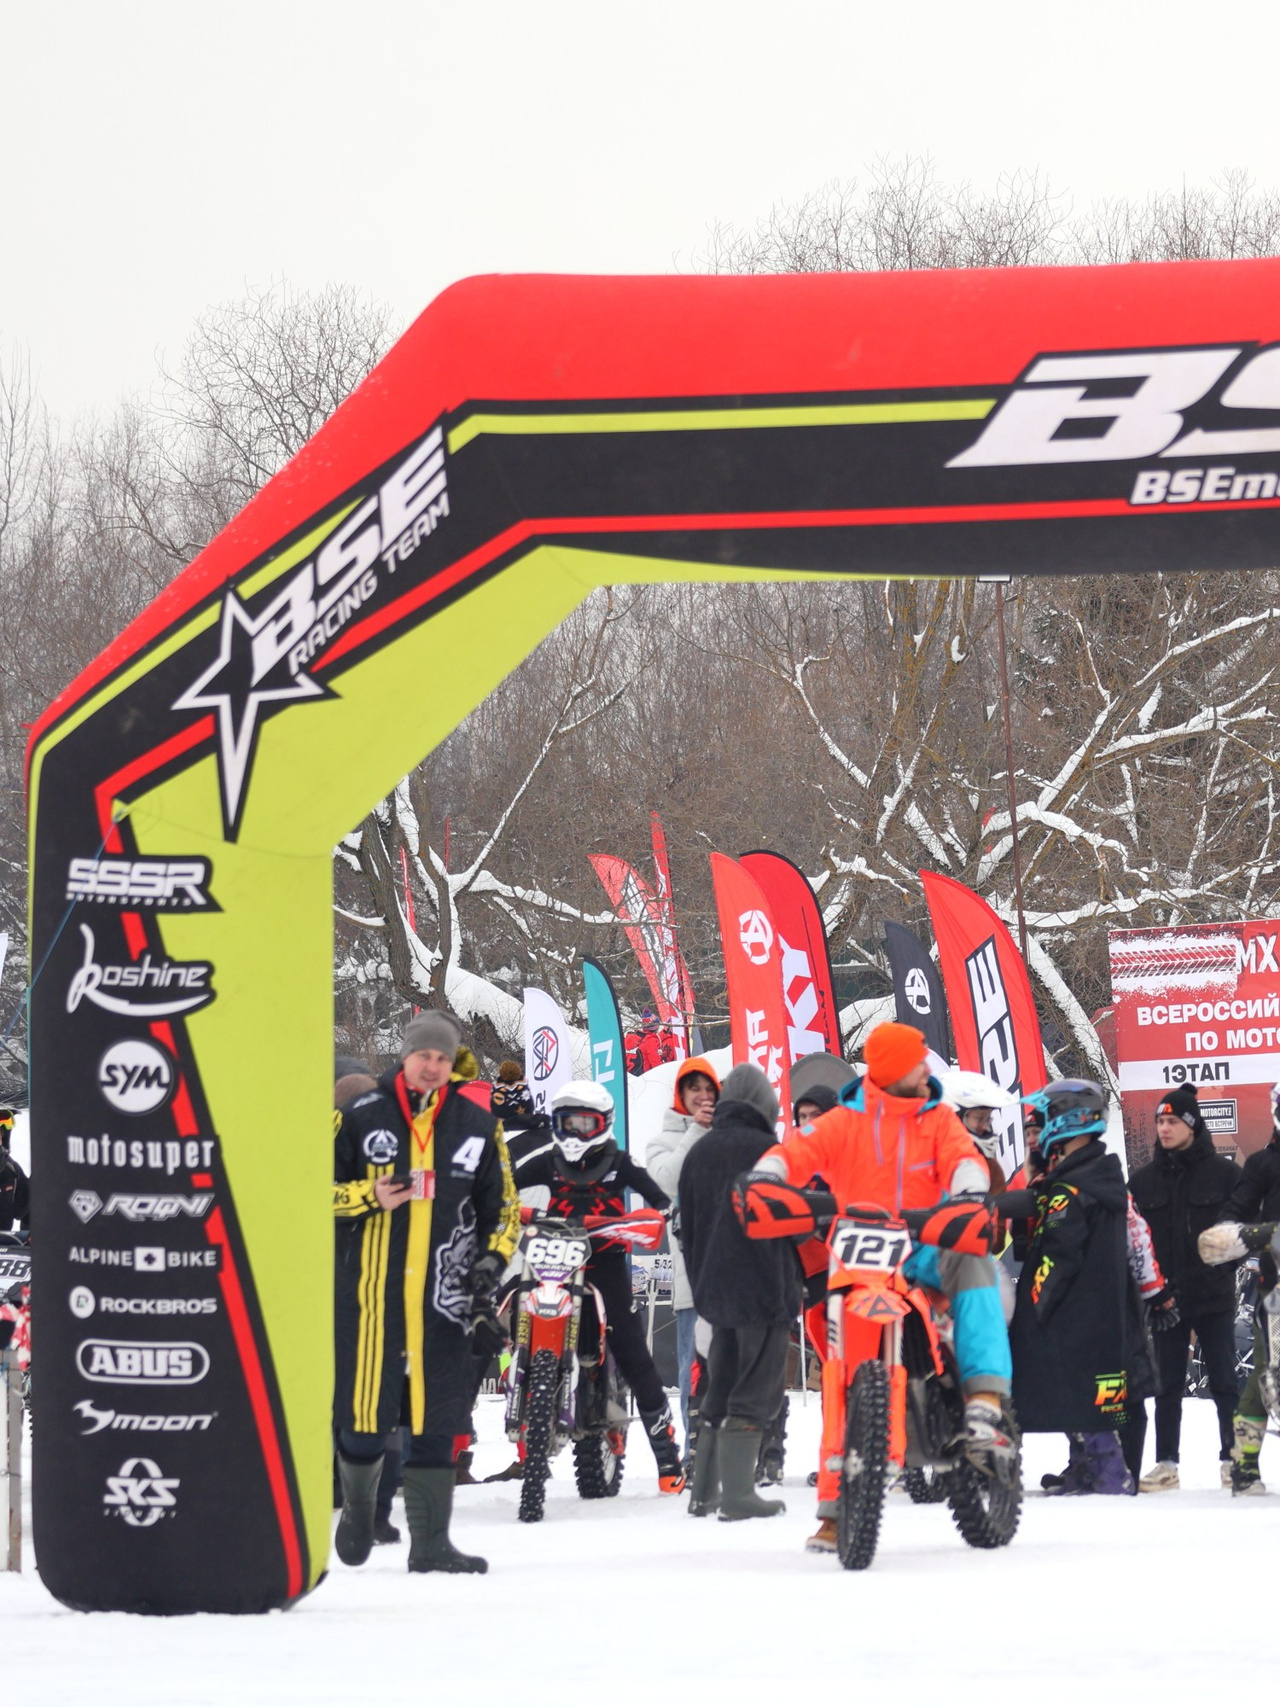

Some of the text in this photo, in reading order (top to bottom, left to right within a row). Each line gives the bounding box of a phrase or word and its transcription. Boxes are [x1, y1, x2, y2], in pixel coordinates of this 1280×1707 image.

[250, 424, 448, 688] BSE
[287, 491, 450, 678] RACING TEAM
[67, 857, 207, 905] SSSR
[1185, 1031, 1217, 1052] ПО
[101, 1064, 170, 1089] SYM
[66, 1132, 215, 1176] motosuper
[452, 1135, 486, 1173] 4
[69, 1246, 217, 1268] ALPINE BIKE
[525, 1237, 586, 1267] 696
[840, 1233, 906, 1267] 121
[101, 1297, 217, 1315] ROCKBROS
[88, 1344, 194, 1377] ABUS
[111, 1411, 214, 1431] moon
[103, 1476, 181, 1506] SKS
